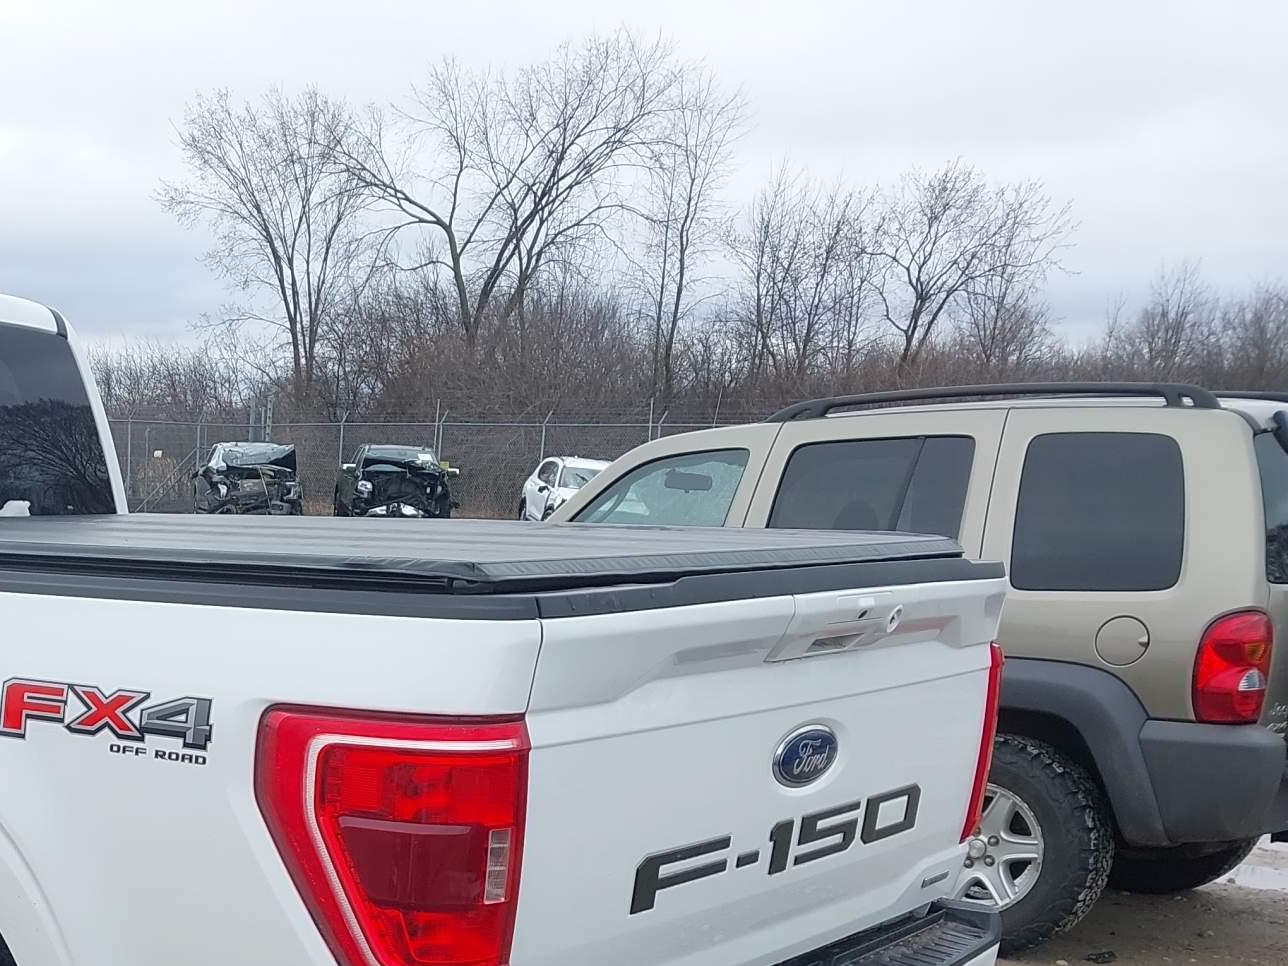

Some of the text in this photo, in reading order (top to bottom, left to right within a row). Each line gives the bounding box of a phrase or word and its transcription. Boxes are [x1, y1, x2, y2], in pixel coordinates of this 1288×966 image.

[109, 743, 207, 766] OFF ROAD
[793, 738, 830, 775] Ford
[630, 782, 922, 915] F-150
